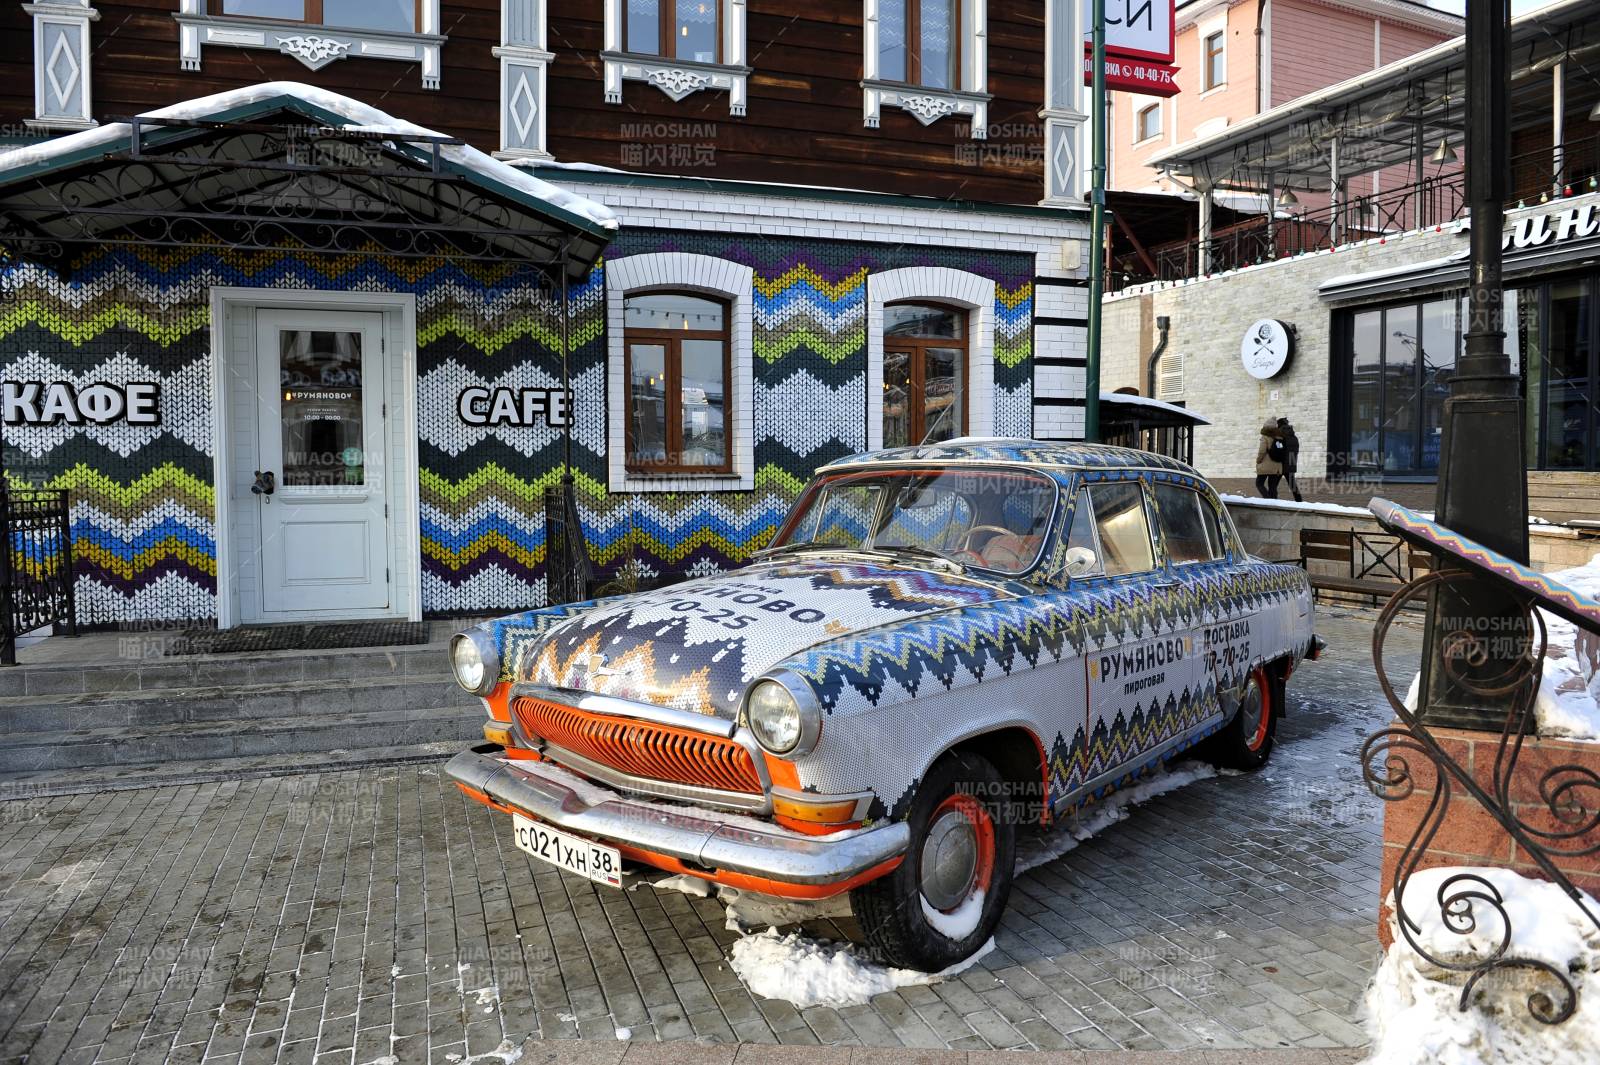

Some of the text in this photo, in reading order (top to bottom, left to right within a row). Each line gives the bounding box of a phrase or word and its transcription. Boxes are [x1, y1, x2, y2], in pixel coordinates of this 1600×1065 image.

[1134, 66, 1171, 84] 40-40-75
[2, 382, 160, 425] КАФЕ
[297, 392, 347, 400] РУМЯНОВО
[459, 387, 574, 426] CAFE
[1204, 620, 1250, 647] ДОСТАВКА
[1101, 637, 1184, 683] РУМЯНОВО
[1203, 641, 1250, 675] 70-70-25
[1124, 671, 1165, 696] пироговая
[591, 848, 613, 873] 38
[592, 870, 608, 881] RUS
